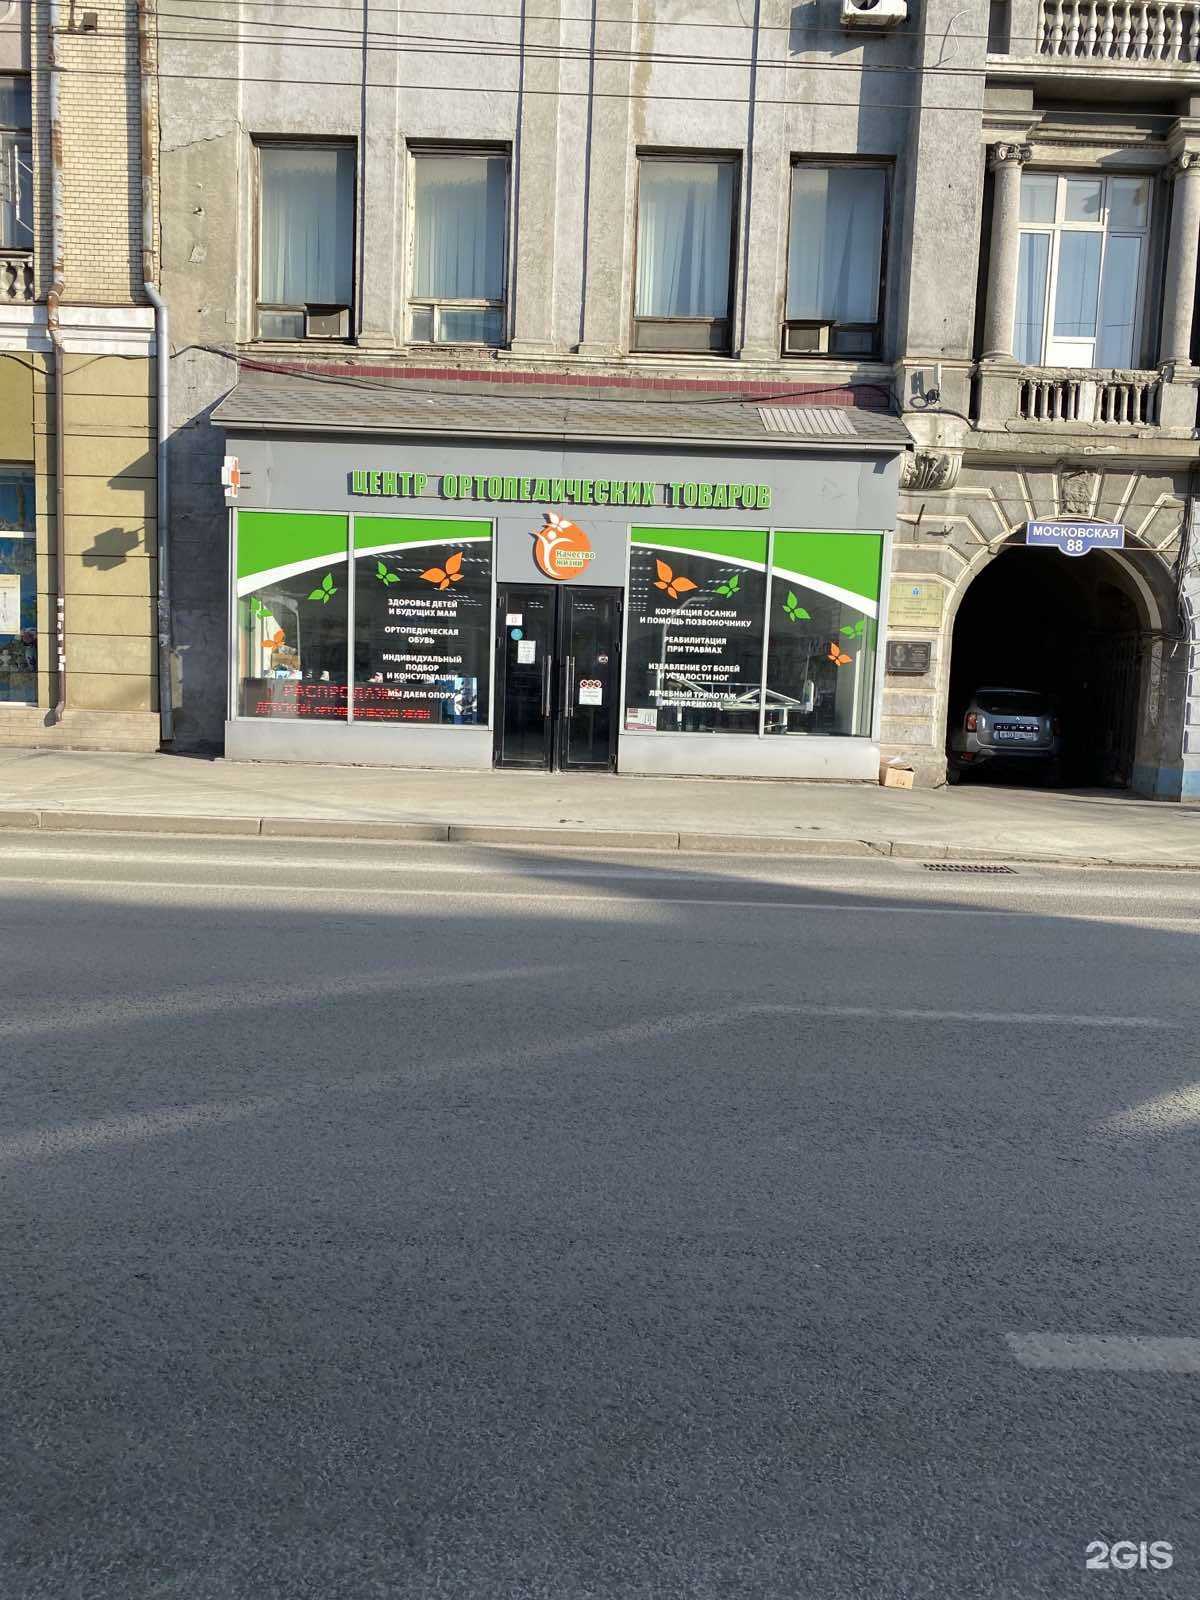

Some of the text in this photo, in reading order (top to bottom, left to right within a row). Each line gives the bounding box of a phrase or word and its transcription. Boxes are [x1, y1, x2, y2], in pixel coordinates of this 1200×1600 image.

[351, 469, 772, 508] ЦЕНТР ОРТОПЕДИЧЕСКИХ ТОВАРОВ
[1033, 525, 1119, 539] МОСКОВСКАЯ
[1066, 539, 1083, 552] 88
[388, 598, 458, 608] ЗДОРОВЬЕ ДЕТЕЙ
[388, 607, 457, 617] И БУДУЩИХ МАМ
[655, 608, 737, 618] КОРРЕКЦИЯ ОСАНКИ
[640, 616, 752, 628] И ПОМОЩЬ ПОЗВОНОЧНИКУ
[384, 626, 459, 636] ОРТОПЕДИЧЕСКАЯ
[408, 636, 435, 645] ОБУВЬ
[664, 636, 727, 646] РЕАБИЛИТАЦИЯ
[667, 645, 722, 654] ПРИ ТРАВМАХ
[382, 653, 462, 663] ИНДИВИДУАЛЬНЫЙ
[405, 663, 440, 672] ПОДБОР
[648, 663, 700, 671] ИЗБАВЛЕНИЕ
[713, 664, 740, 673] БОЛЕЙ
[666, 672, 712, 681] УСТАЛОСТИ
[713, 674, 729, 682] НОГ
[388, 690, 456, 699] МЫ ДАЕМ ОПОРУ
[648, 689, 737, 700] ЛЕЧЕБНЫЙ ТРИКОТАЖ
